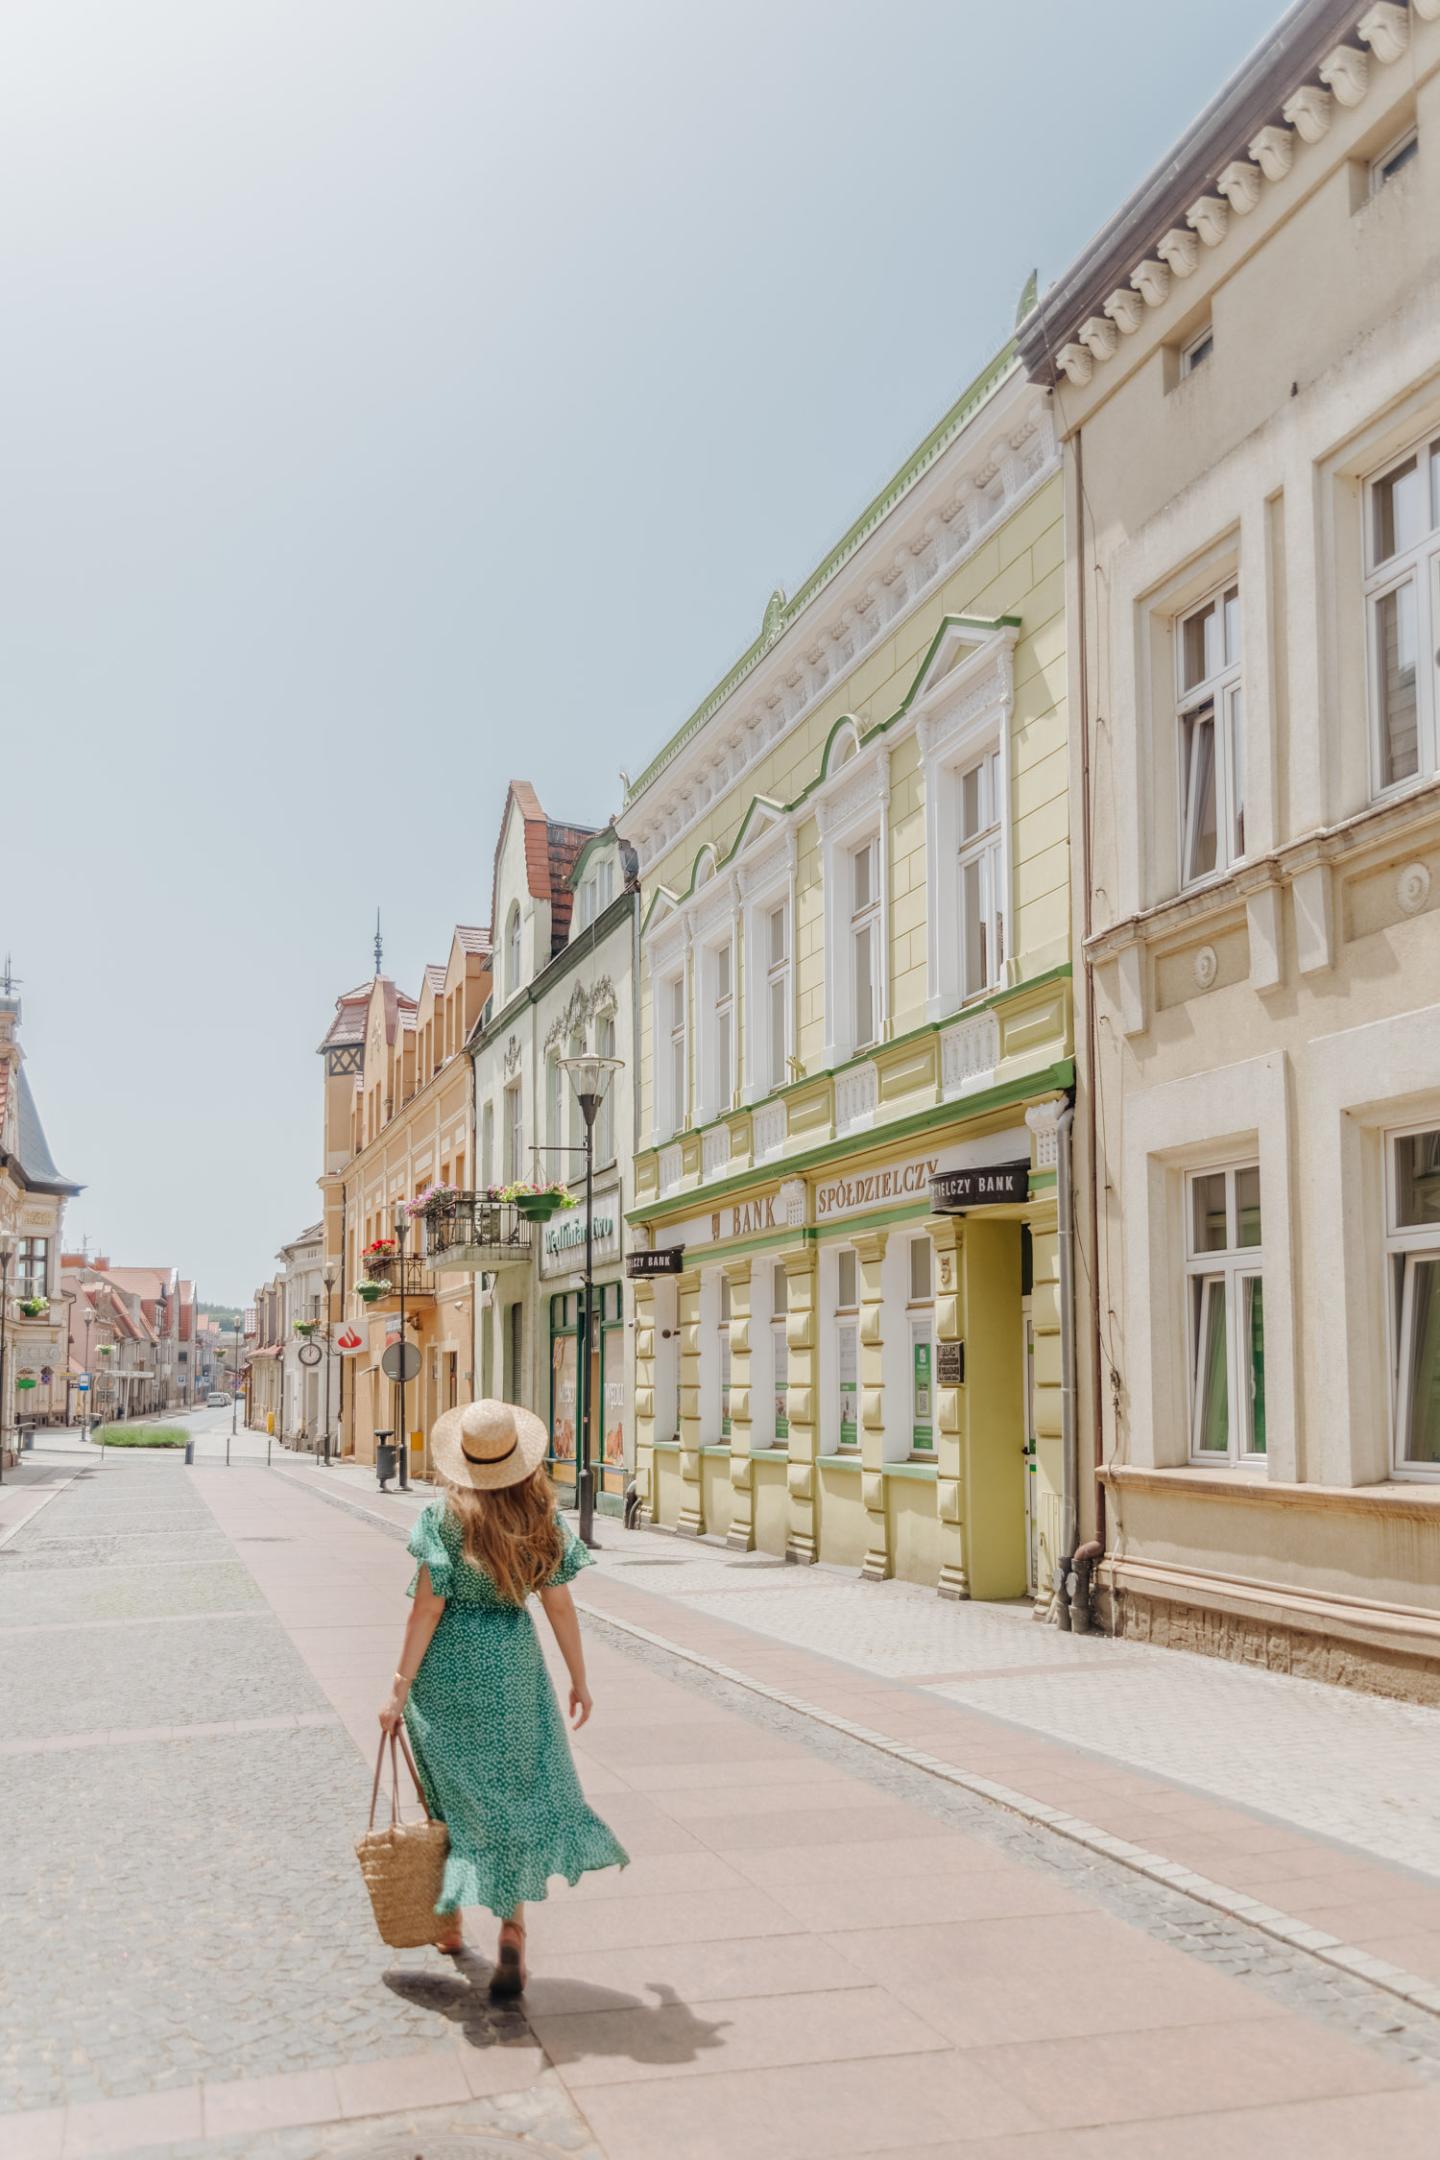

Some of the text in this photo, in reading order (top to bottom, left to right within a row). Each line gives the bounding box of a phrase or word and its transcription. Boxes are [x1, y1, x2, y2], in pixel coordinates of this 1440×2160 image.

[978, 1175, 1014, 1193] BANK
[733, 1195, 776, 1238] BANK
[647, 1255, 671, 1268] BANK
